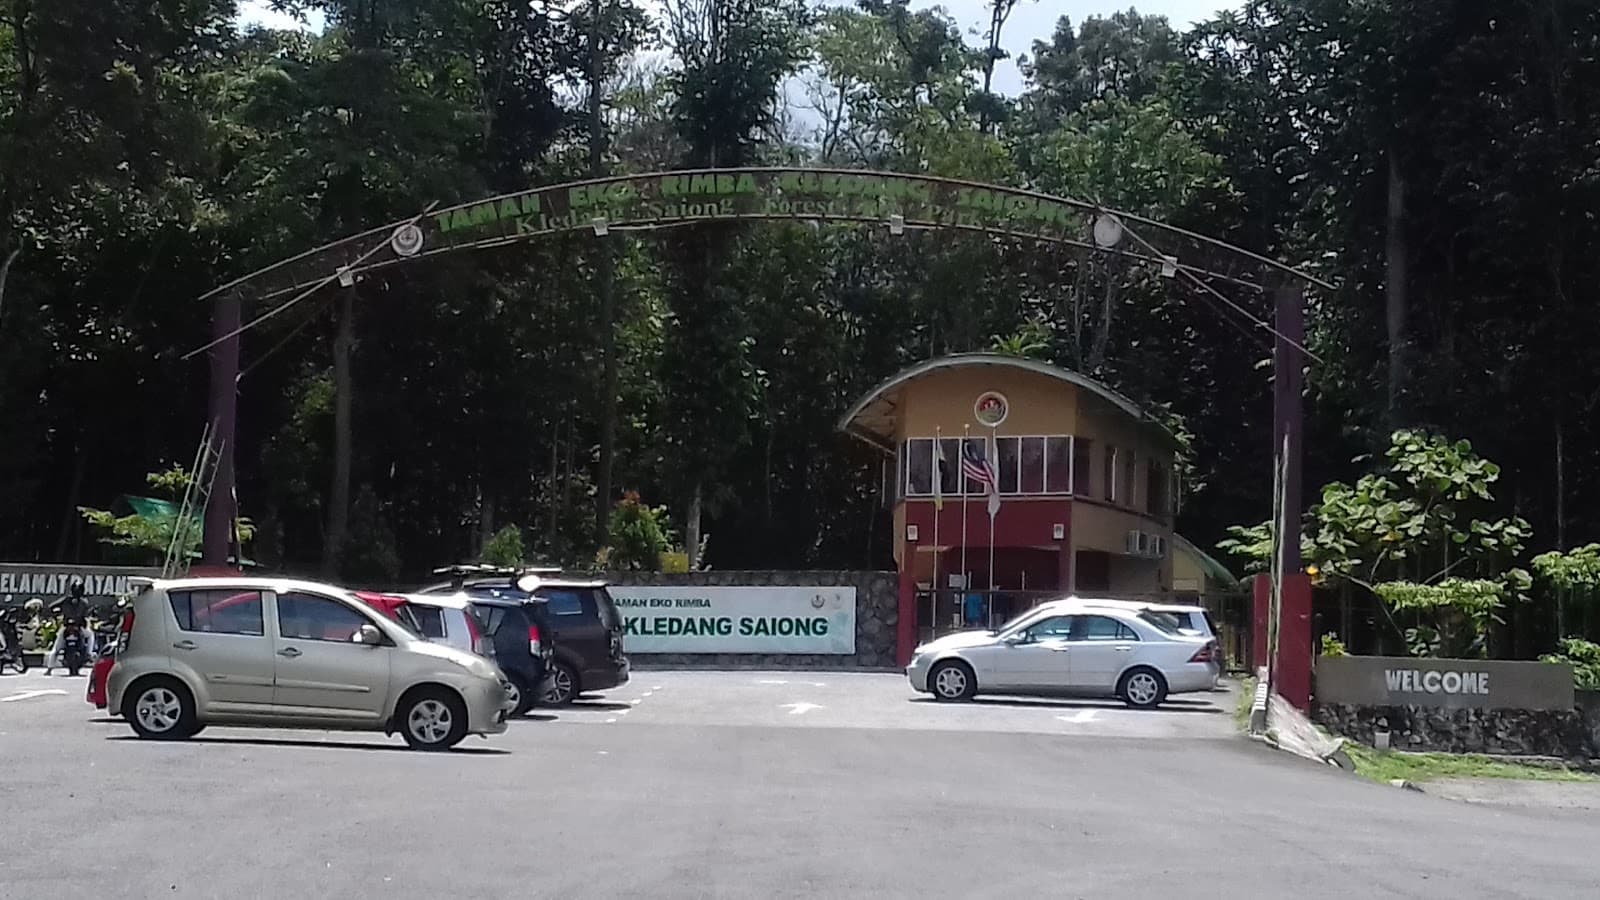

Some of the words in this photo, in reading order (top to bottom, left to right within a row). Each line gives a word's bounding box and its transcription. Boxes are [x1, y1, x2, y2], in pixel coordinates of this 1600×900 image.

[435, 192, 540, 233] TAMAN
[661, 173, 756, 196] RIMBA
[650, 196, 735, 220] Saiong
[0, 573, 68, 594] ELAMAT
[612, 598, 647, 608] AMAN
[650, 599, 672, 608] EKO
[675, 599, 711, 608] RIMBA
[624, 617, 732, 636] KLEDANG
[739, 617, 828, 636] SAIONG
[1385, 669, 1489, 695] WELCOME
